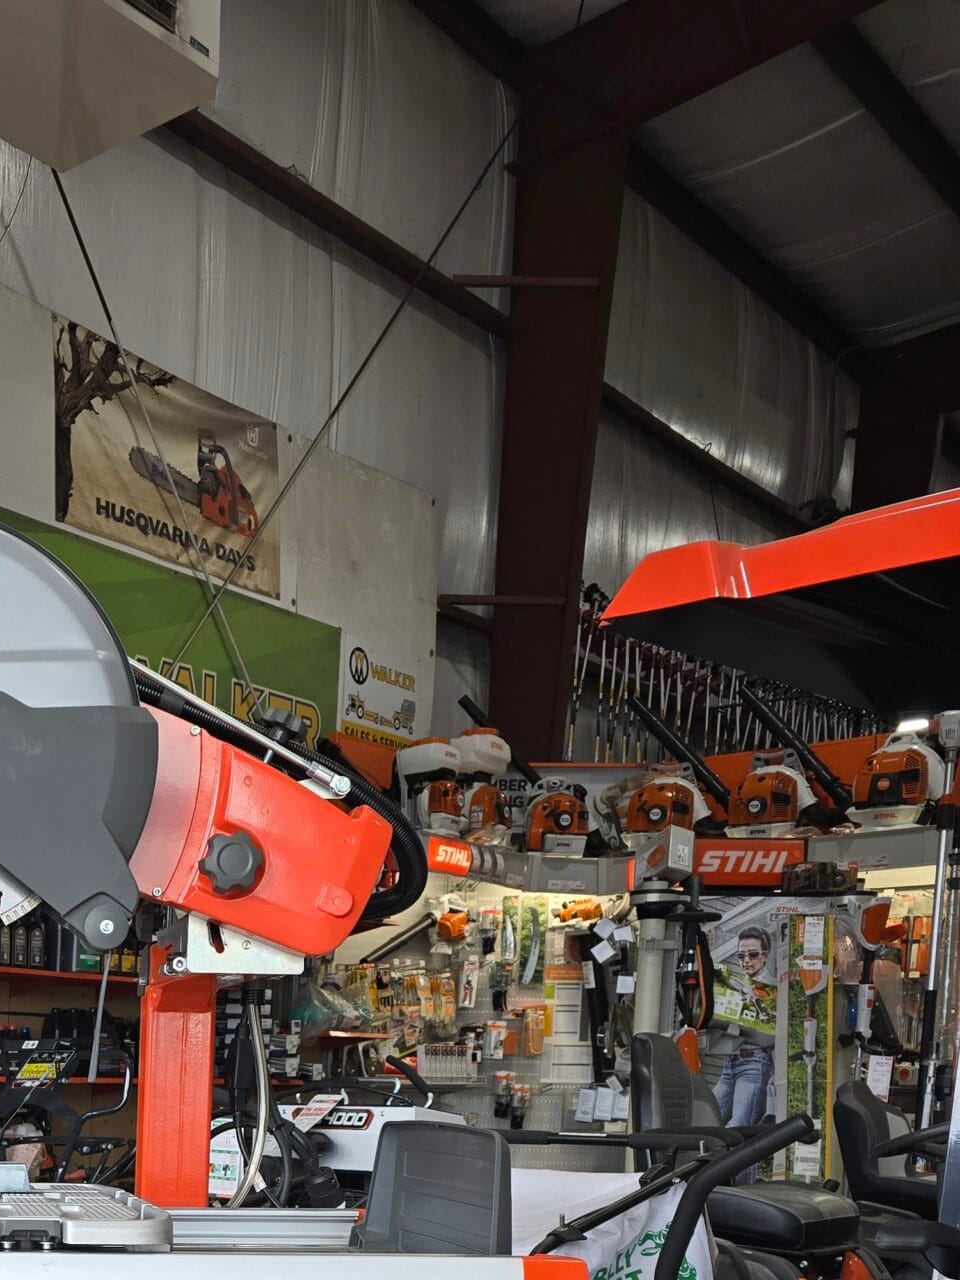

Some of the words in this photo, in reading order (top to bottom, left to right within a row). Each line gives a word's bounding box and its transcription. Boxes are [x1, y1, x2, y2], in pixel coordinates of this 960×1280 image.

[95, 497, 211, 554] HUSQVARNA
[215, 543, 256, 572] DAYS
[370, 661, 416, 692] WALKER
[873, 811, 898, 821] STIHL
[435, 844, 471, 866] STIHL
[698, 850, 788, 874] STIHL
